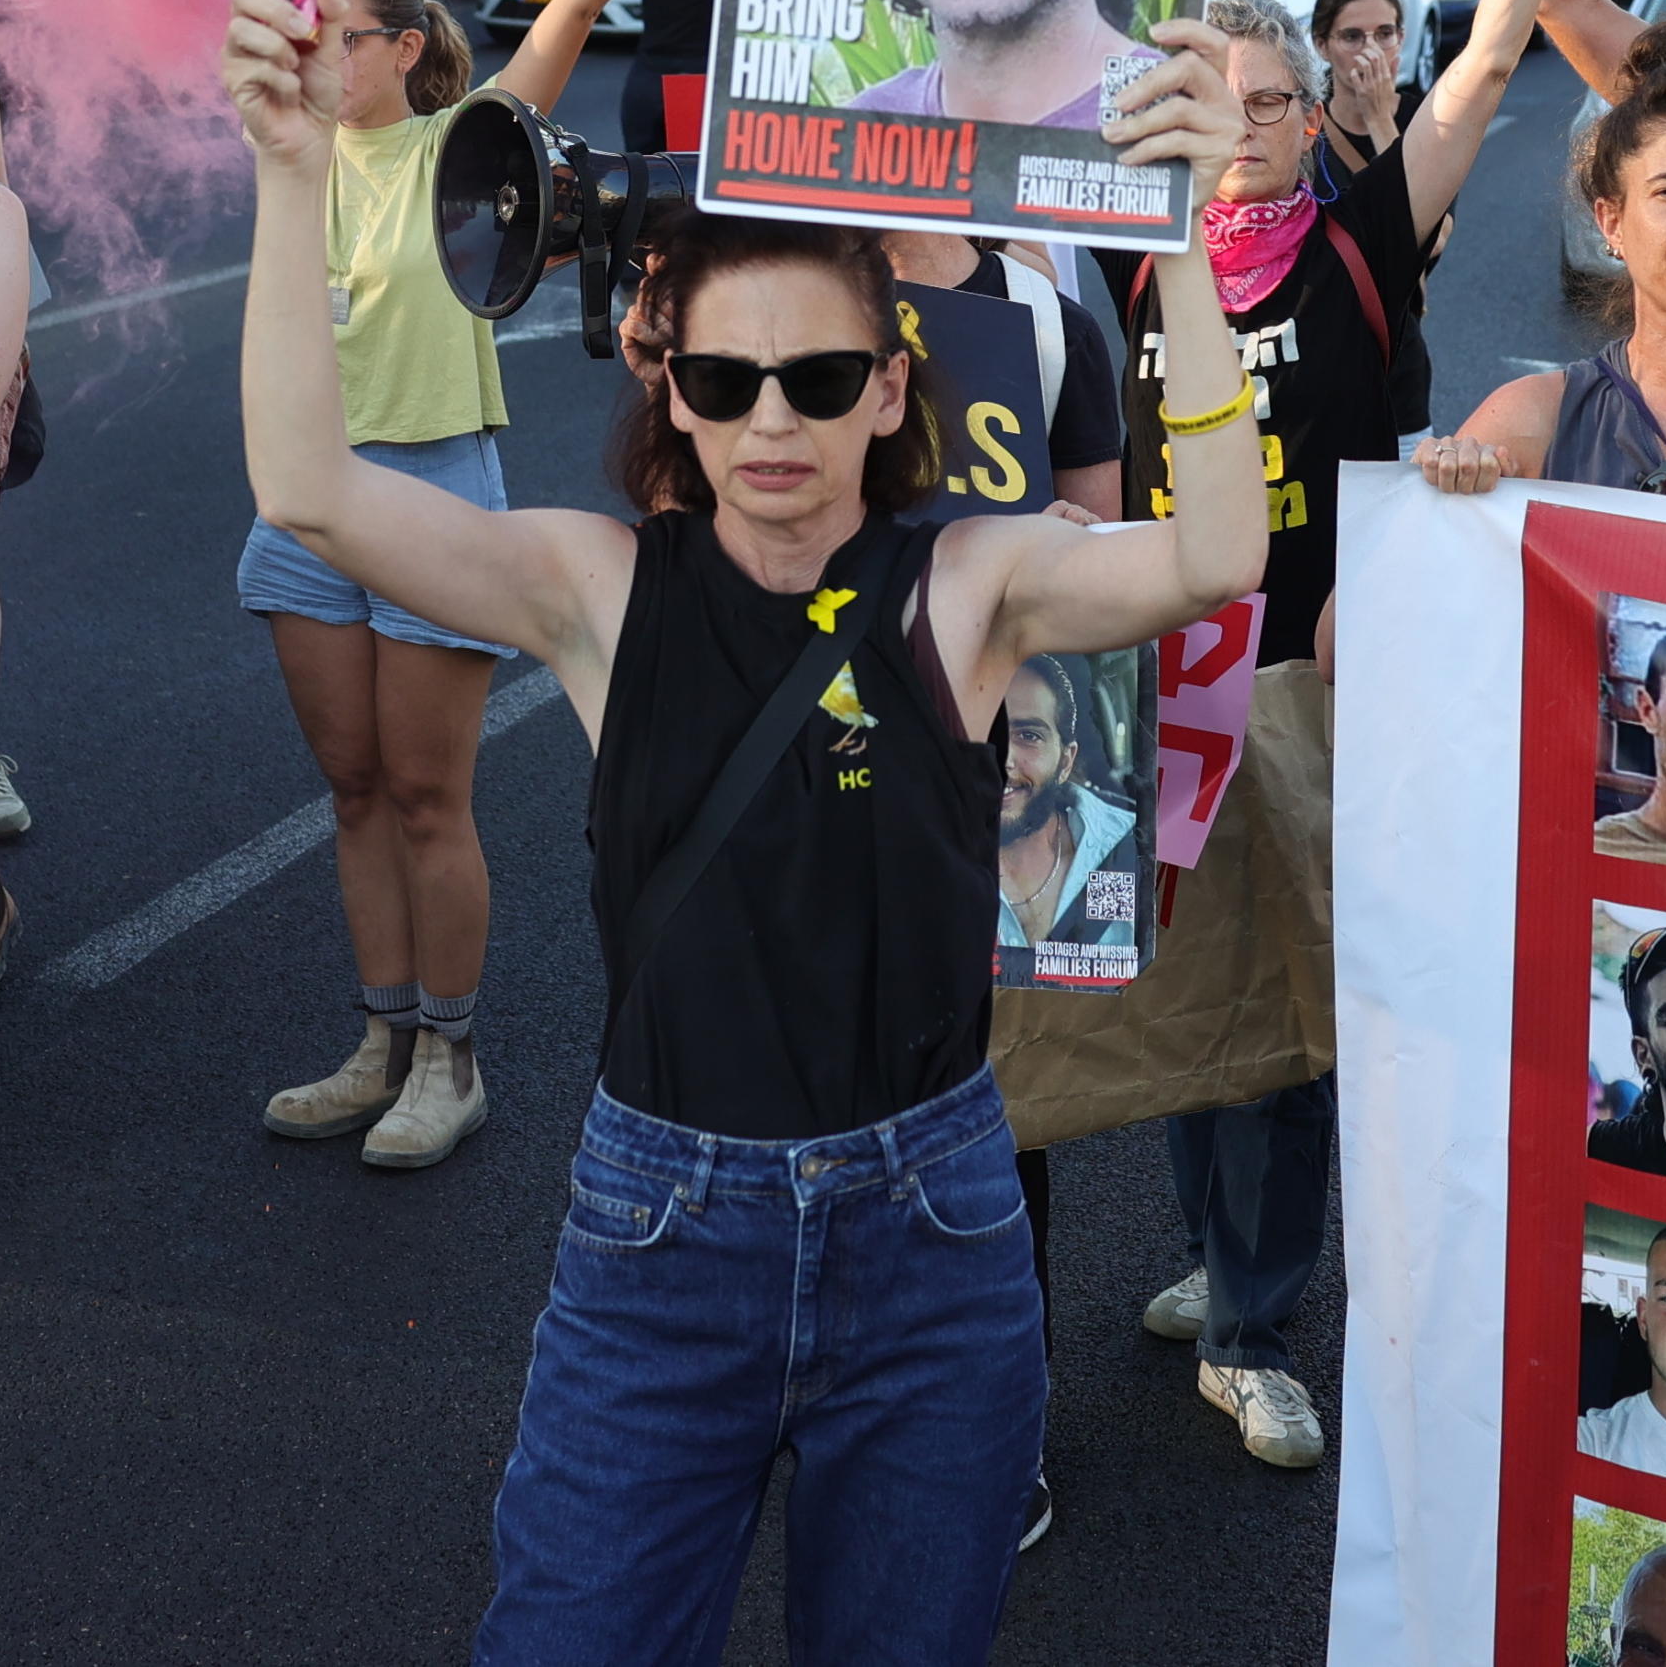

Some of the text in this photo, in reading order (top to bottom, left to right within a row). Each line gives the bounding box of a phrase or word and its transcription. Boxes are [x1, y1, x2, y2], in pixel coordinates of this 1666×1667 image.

[731, 39, 813, 103] HIM
[725, 109, 976, 192] HOME NOW!
[1019, 155, 1171, 187] HOSTAGES AND MISSING
[1017, 177, 1170, 217] FAMILIES FORUM
[838, 768, 872, 791] HC
[1036, 941, 1138, 960] HOSTAGES AND MISSING
[1035, 956, 1138, 979] FAMILIES FORUM
